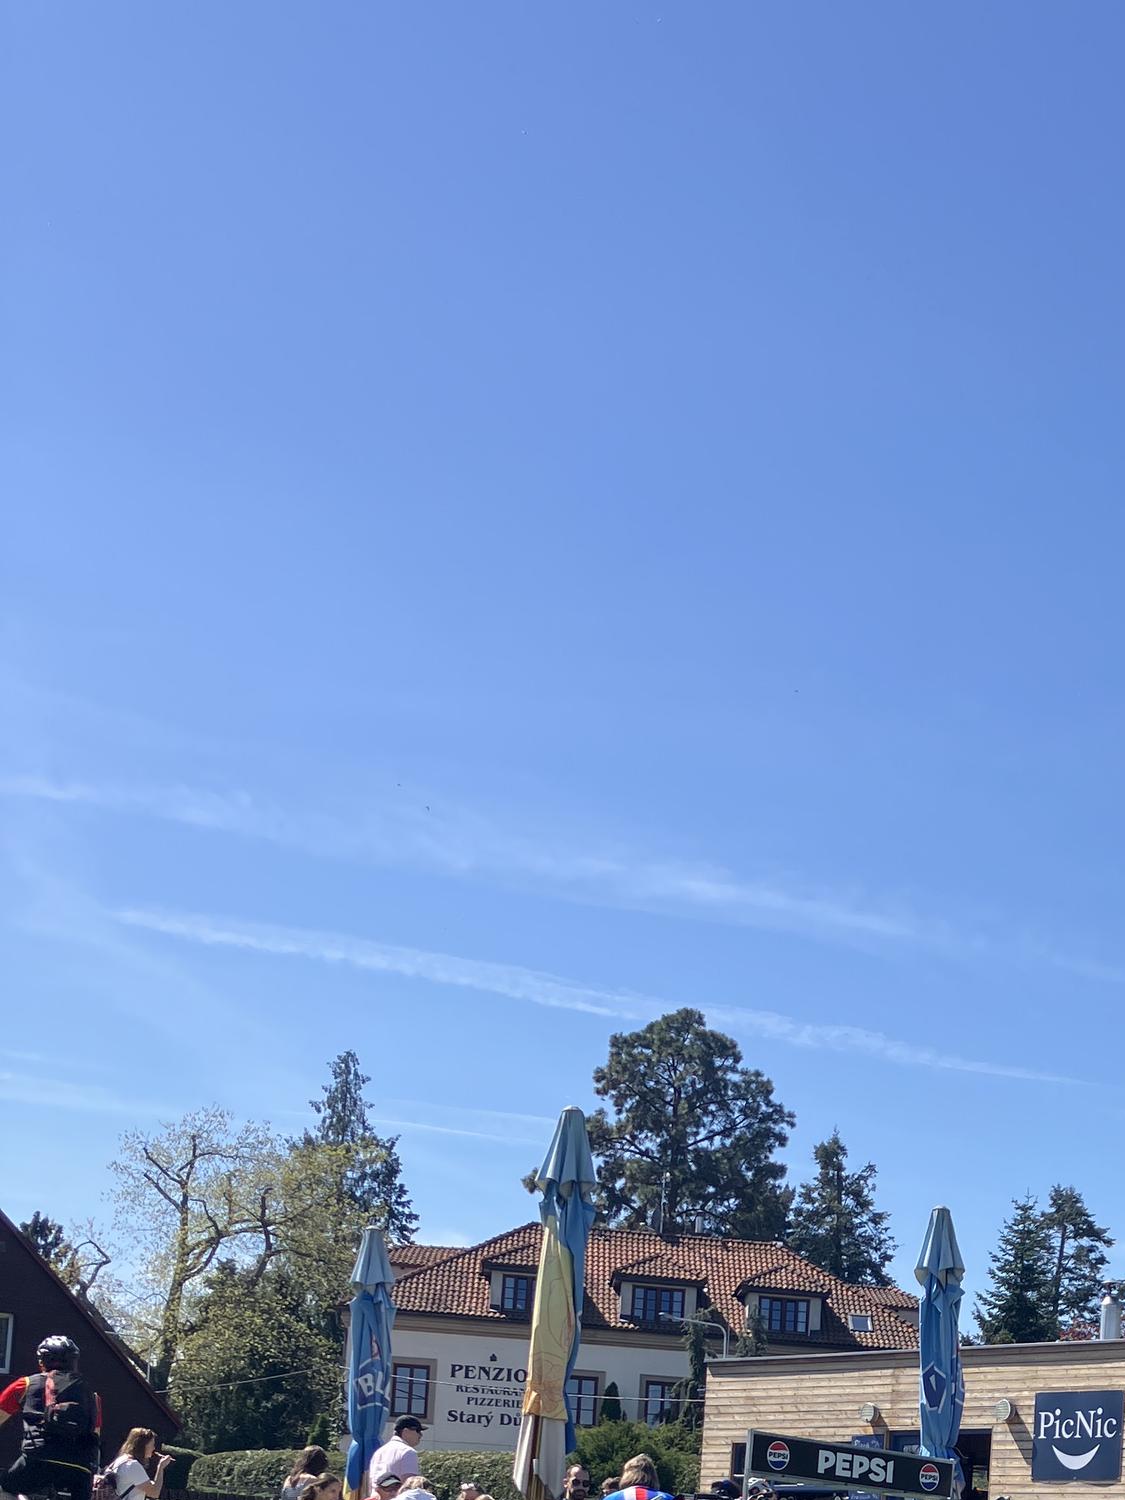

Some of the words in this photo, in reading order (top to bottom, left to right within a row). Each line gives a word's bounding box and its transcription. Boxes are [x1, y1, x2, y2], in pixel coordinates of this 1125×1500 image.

[450, 1364, 528, 1383] PENZIO
[447, 1409, 494, 1427] Starý
[499, 1412, 522, 1426] Dů
[1038, 1407, 1117, 1438] PicNic
[768, 1451, 789, 1459] PEPSI
[817, 1450, 894, 1483] PEPSI
[920, 1473, 938, 1481] PEPSI
